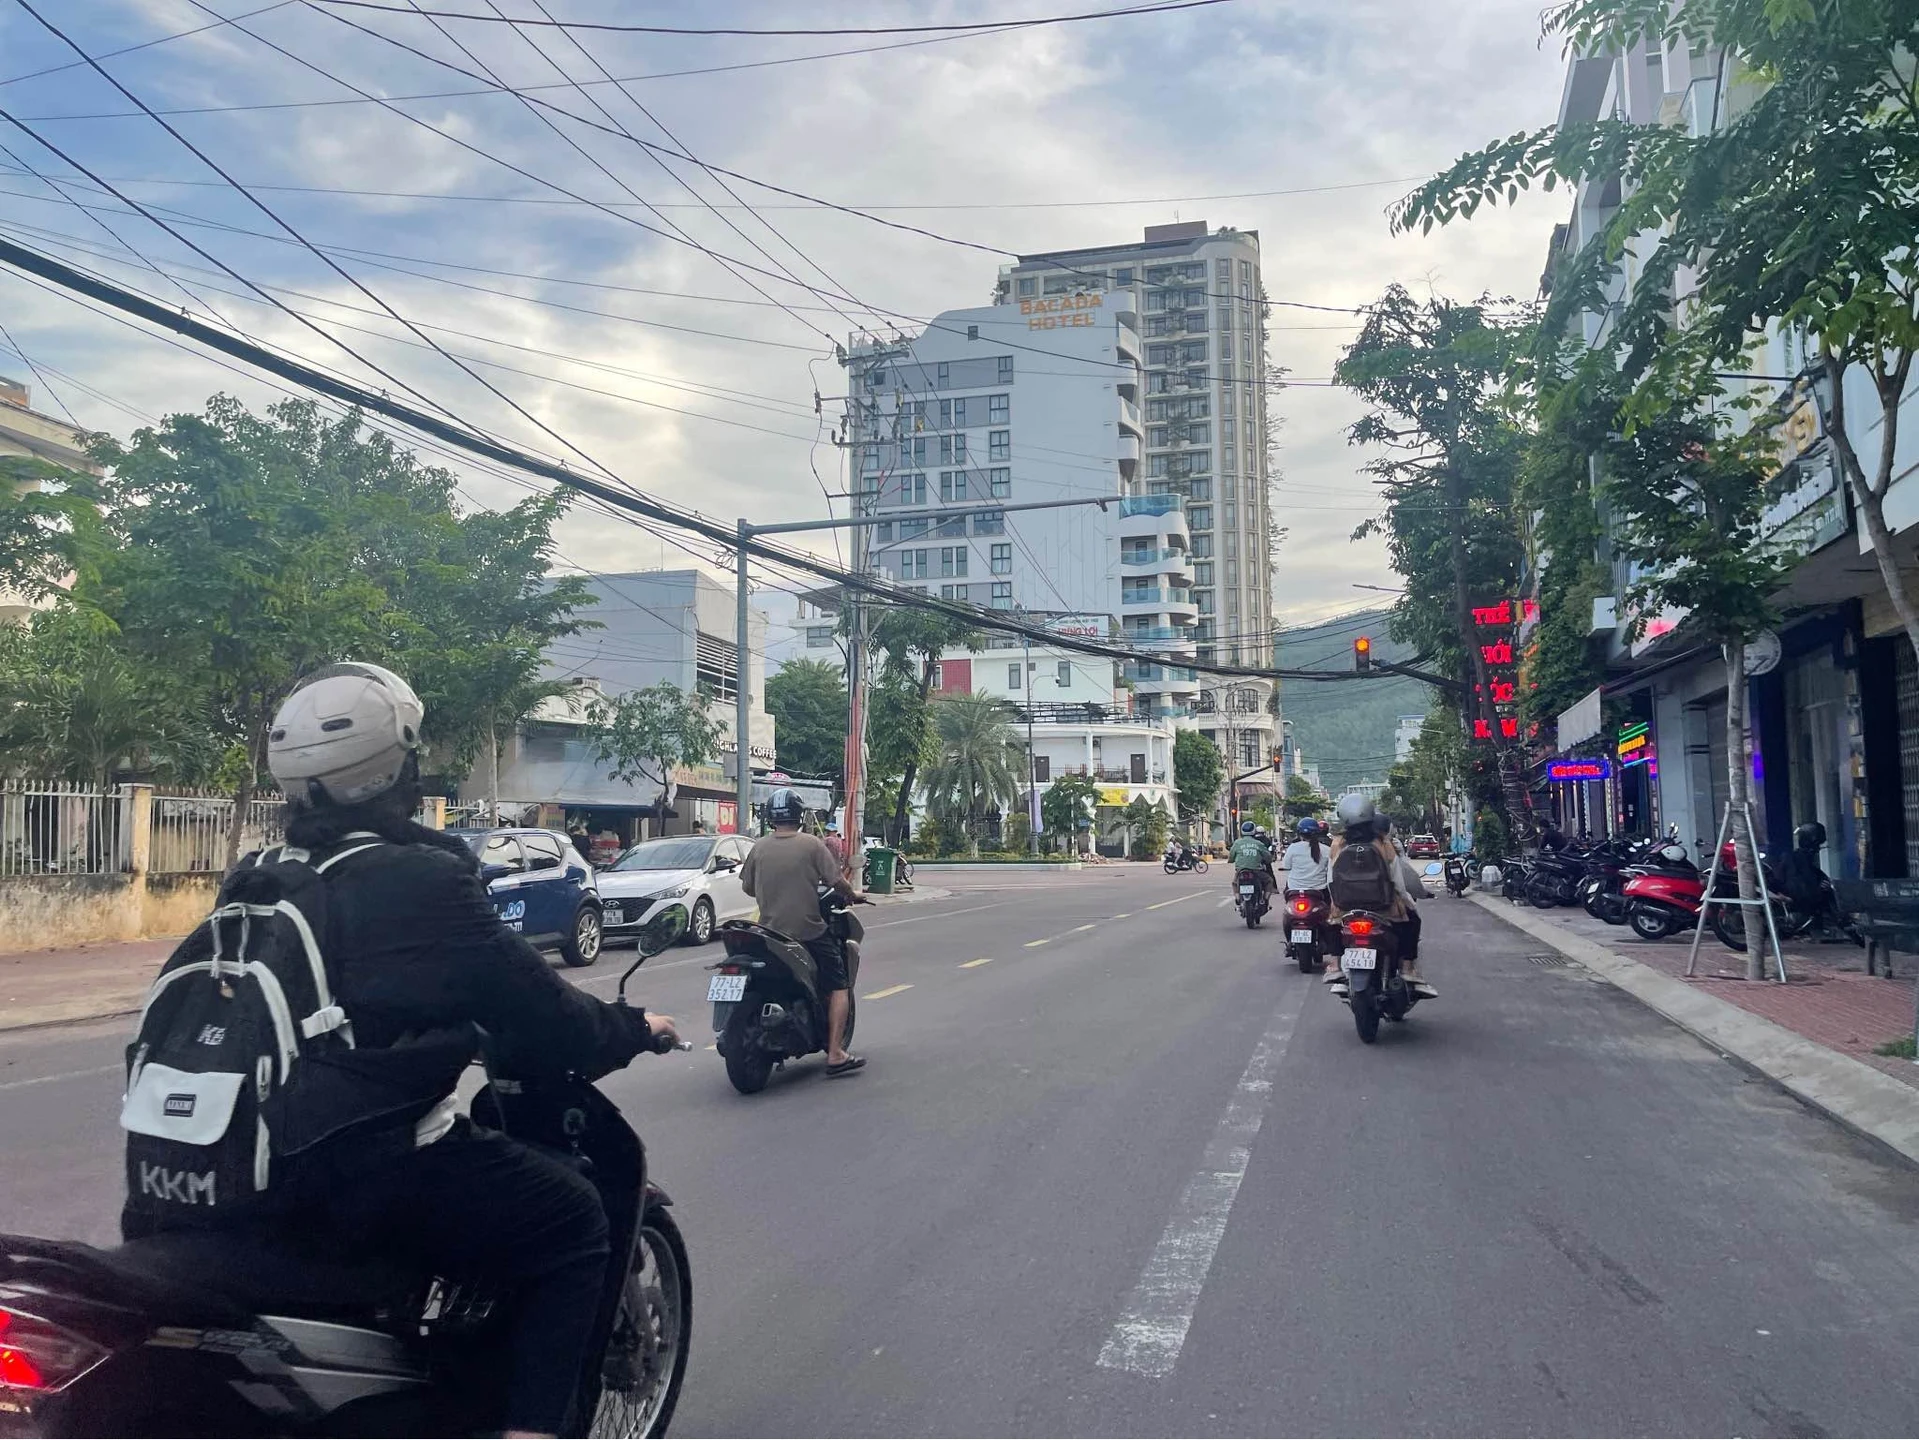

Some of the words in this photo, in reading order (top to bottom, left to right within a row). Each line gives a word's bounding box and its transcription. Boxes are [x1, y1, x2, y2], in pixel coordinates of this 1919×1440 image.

[1029, 313, 1095, 331] HOTEL
[1472, 600, 1511, 625] THẾ
[1474, 718, 1517, 738] NM
[753, 746, 777, 760] COFFEE
[139, 1160, 216, 1207] KKM
